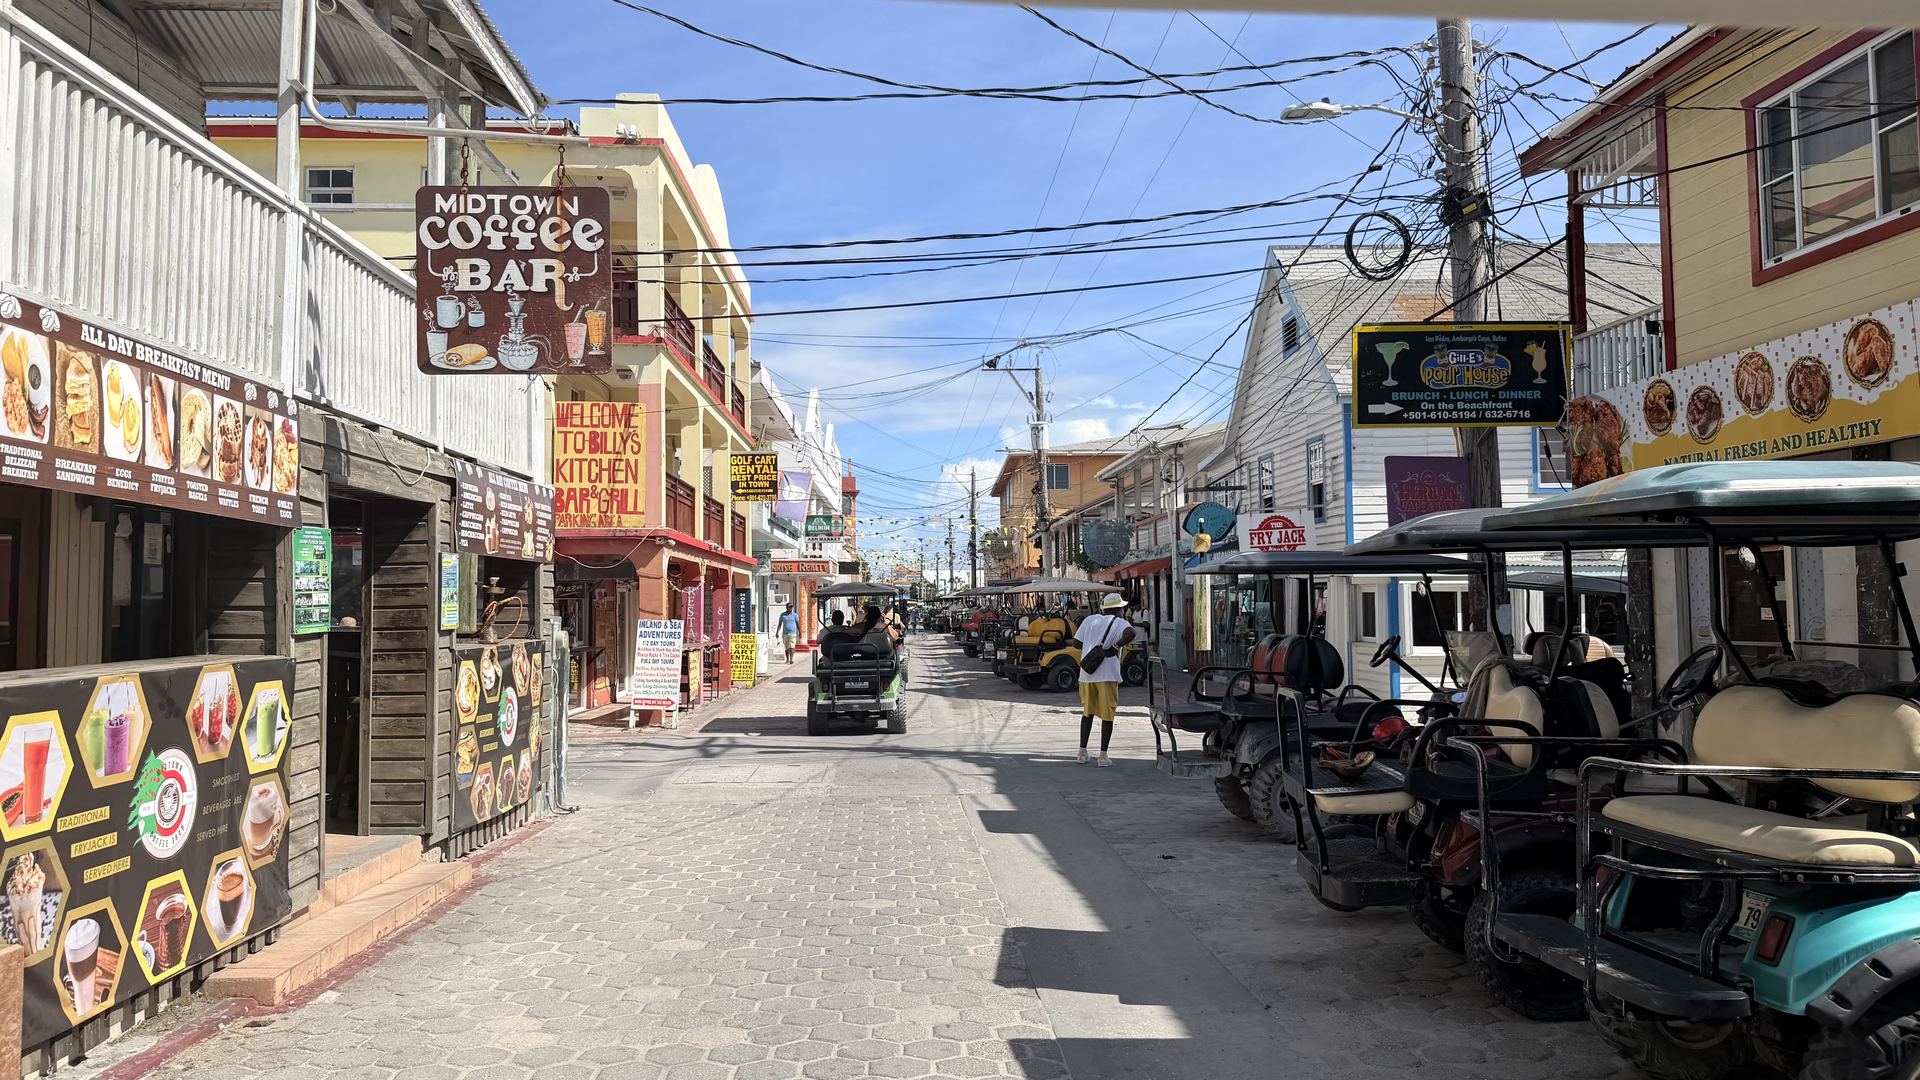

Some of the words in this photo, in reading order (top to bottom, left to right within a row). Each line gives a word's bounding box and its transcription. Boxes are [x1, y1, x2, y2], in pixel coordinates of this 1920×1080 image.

[435, 193, 579, 216] MIDTOWN
[454, 257, 574, 313] BAR
[80, 323, 106, 349] ALL
[108, 333, 134, 358] DAY
[135, 343, 200, 383] BREAKFAST
[202, 367, 231, 391] MENU
[1391, 391, 1440, 401] BRUNCH
[1449, 391, 1489, 400] LUNCH
[1498, 390, 1542, 399] DINNER
[1420, 402, 1435, 410] On
[1438, 401, 1455, 410] the
[1457, 401, 1513, 409] Beachfront
[556, 403, 639, 429] WELCOME
[1402, 411, 1477, 419] +501-610-5194
[1485, 410, 1531, 419] 632-6716
[1724, 441, 1768, 461] FRESH
[1771, 433, 1802, 455] AND
[1806, 418, 1882, 448] HEALTHY
[0, 444, 43, 459] TRADITIONAL
[5, 456, 37, 469] BELIZEAN
[55, 458, 97, 474] BREAKFAST
[731, 455, 753, 465] GOLF
[754, 455, 777, 465] CART
[2, 466, 39, 480] BREAKFAST
[115, 468, 132, 479] EGGS
[555, 458, 639, 485] KITCHEN
[731, 465, 778, 474] RENTAL
[56, 470, 95, 485] SANDWICH
[152, 473, 175, 485] STUFFED
[731, 474, 752, 482] BEST
[107, 478, 139, 491] BENEDICT
[186, 481, 208, 492] TOASTED
[188, 490, 208, 502] BAGELS
[218, 488, 238, 499] BELGIAN
[249, 494, 269, 505] FRENCH
[555, 487, 591, 514] BAR
[590, 484, 599, 500] &
[598, 487, 645, 515] GRILL
[219, 497, 239, 508] WAFFLES
[251, 505, 267, 515] TOAST
[280, 510, 292, 519] EGGS
[555, 513, 597, 528] PARKING
[597, 514, 623, 528] AREA
[1249, 531, 1273, 546] FRY
[1277, 529, 1306, 544] JACK
[771, 564, 793, 572] NRISE
[639, 620, 662, 629] INLAND
[663, 620, 668, 629] &
[670, 621, 682, 629] SEA
[639, 630, 682, 639] ADVENTURES
[212, 772, 240, 788] SMOOTHIES
[202, 800, 232, 816] BEVERAGES
[233, 795, 242, 806] ARE
[59, 808, 108, 830] TRADITIONAL
[196, 828, 216, 842] SERVED
[217, 824, 229, 835] HERE
[74, 836, 108, 855] FRYJACK
[109, 834, 116, 844] IS
[84, 863, 113, 881] SERVED
[113, 857, 129, 871] HERE
[1744, 906, 1762, 929] 79
